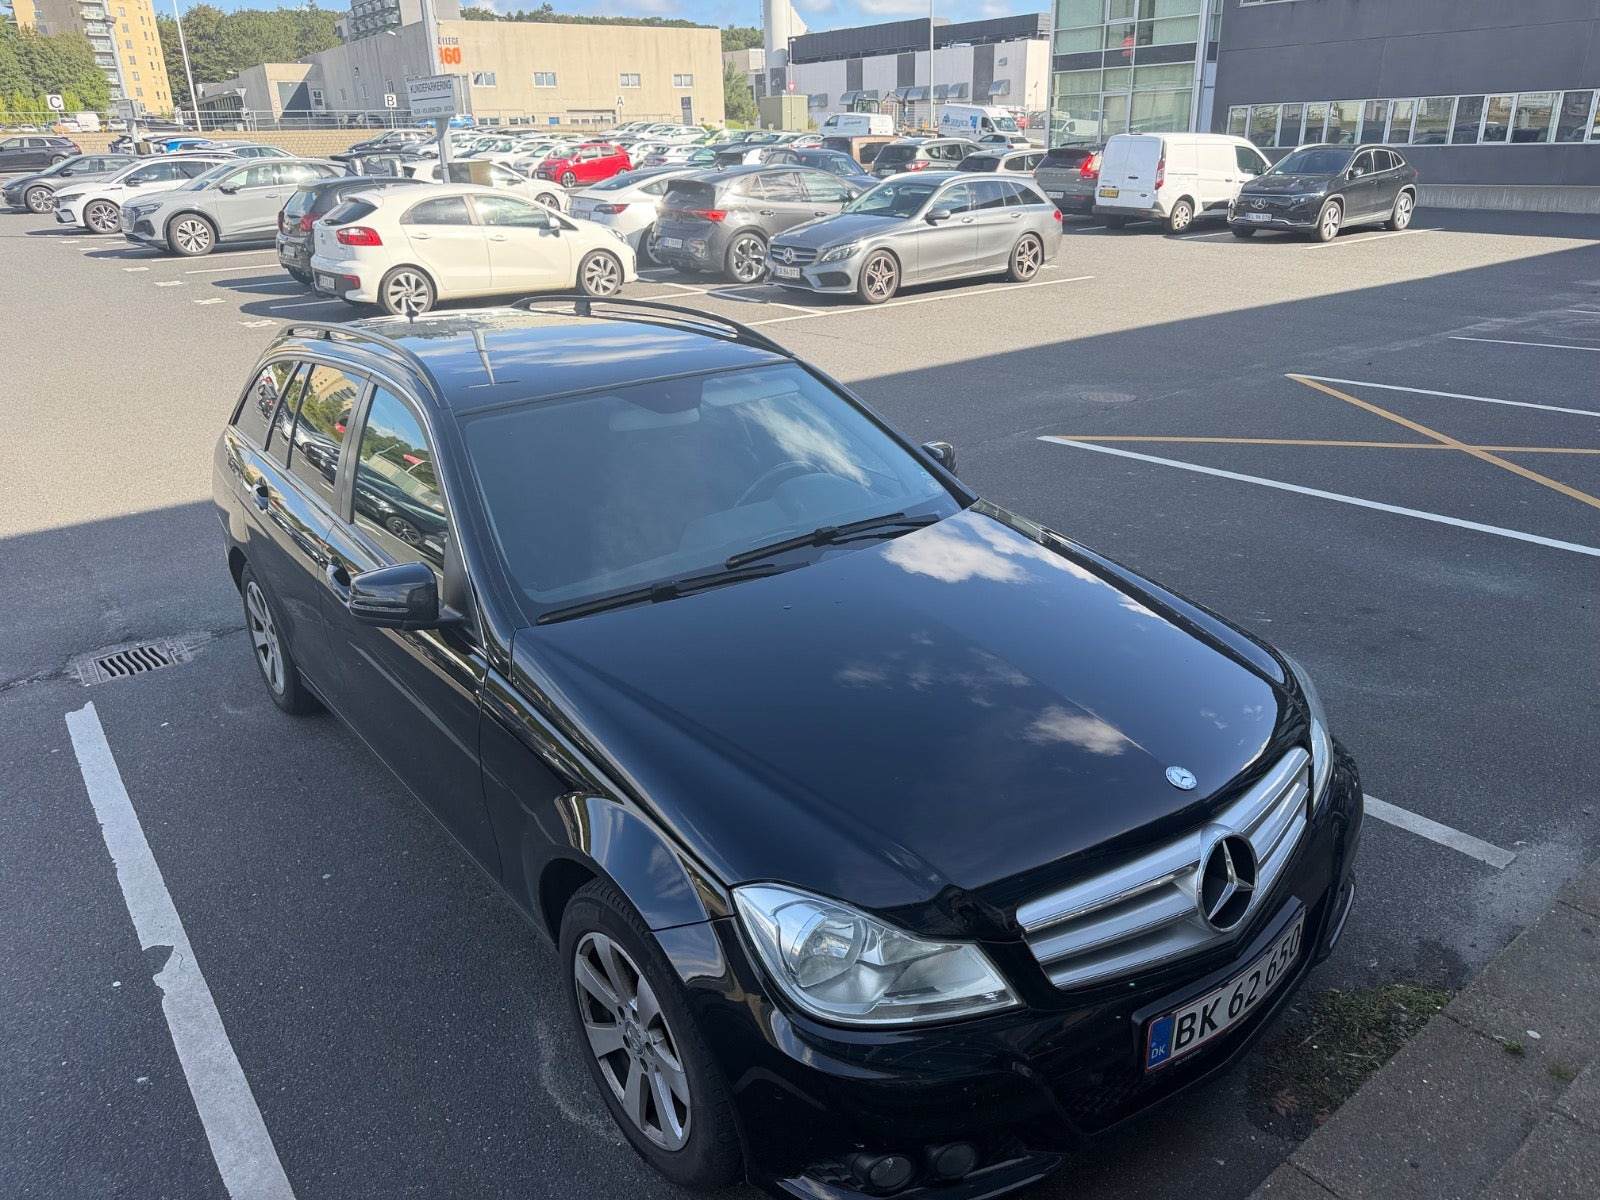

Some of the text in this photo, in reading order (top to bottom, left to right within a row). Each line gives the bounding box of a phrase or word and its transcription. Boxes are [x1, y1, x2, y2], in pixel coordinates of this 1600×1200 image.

[437, 36, 459, 45] OLLEGE
[410, 80, 452, 94] KUNDEPARKERING
[49, 96, 61, 108] C
[387, 95, 395, 106] B
[617, 96, 624, 106] A
[1151, 924, 1301, 1059] DK BK 62 650
